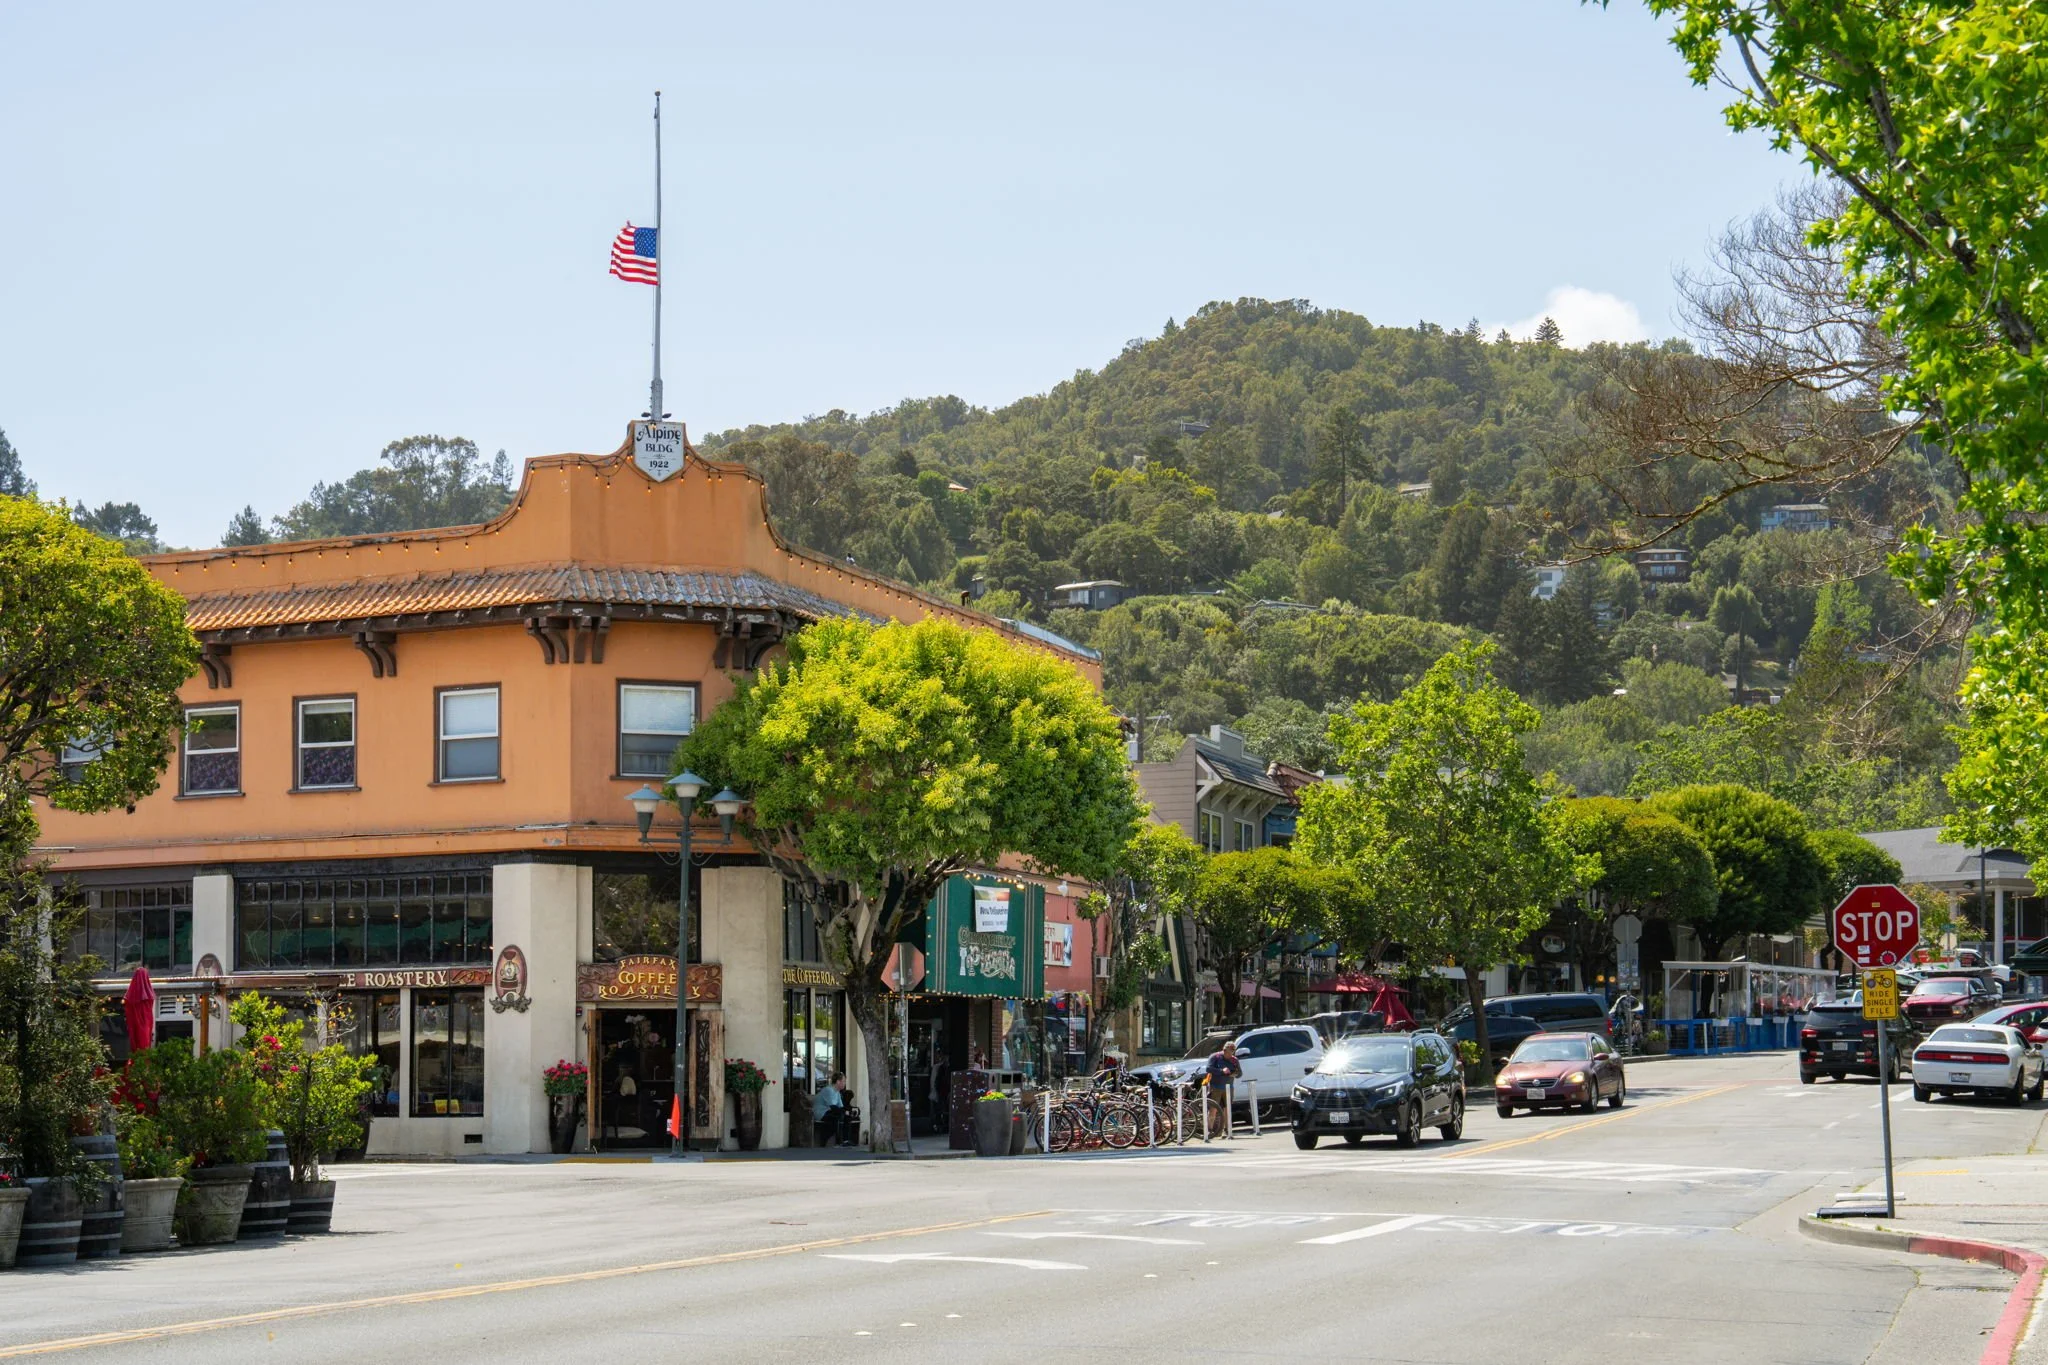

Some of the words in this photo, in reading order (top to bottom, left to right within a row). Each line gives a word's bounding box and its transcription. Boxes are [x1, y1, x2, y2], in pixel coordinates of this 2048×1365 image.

[636, 424, 682, 444] Alpine
[645, 443, 673, 453] BLDG
[649, 460, 669, 468] 1922
[1840, 910, 1914, 943] STOP
[620, 956, 676, 970] FAIRFAX
[364, 970, 447, 987] ROASTERY
[618, 970, 677, 984] COFFEE
[598, 985, 701, 998] ROASTEY
[1869, 990, 1889, 998] RIDE
[1866, 998, 1893, 1006] SINGLE
